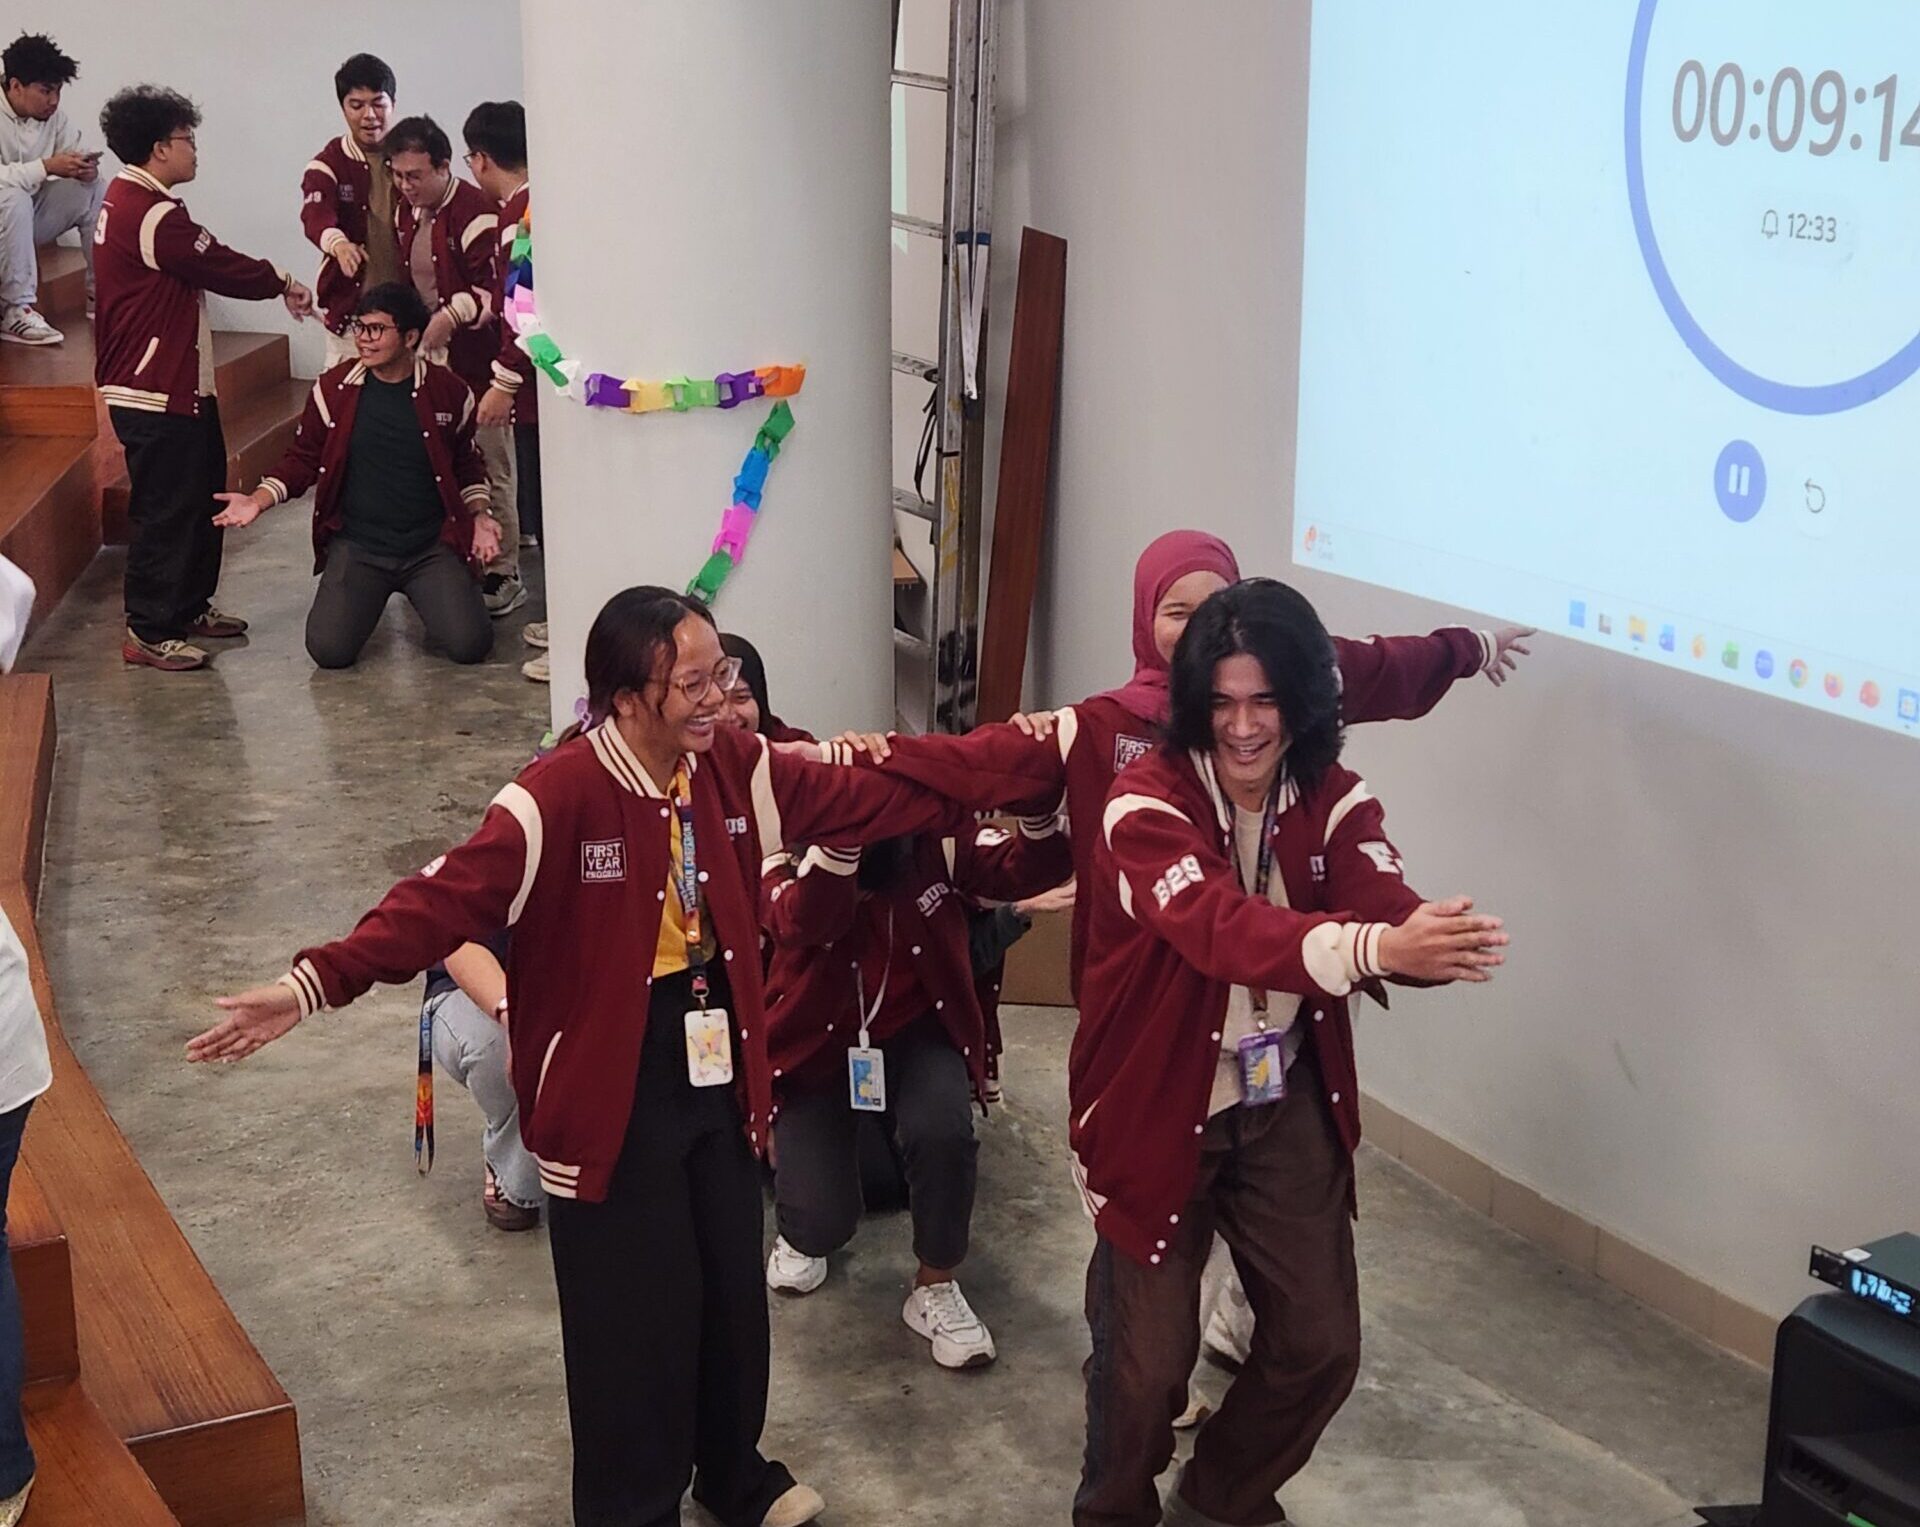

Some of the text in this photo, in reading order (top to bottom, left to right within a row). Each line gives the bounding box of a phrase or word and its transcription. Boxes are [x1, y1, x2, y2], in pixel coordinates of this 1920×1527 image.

[1787, 213, 1837, 243] 12:33
[585, 843, 621, 858] FIRST
[587, 856, 621, 870] YEAR
[1151, 853, 1206, 912] B29
